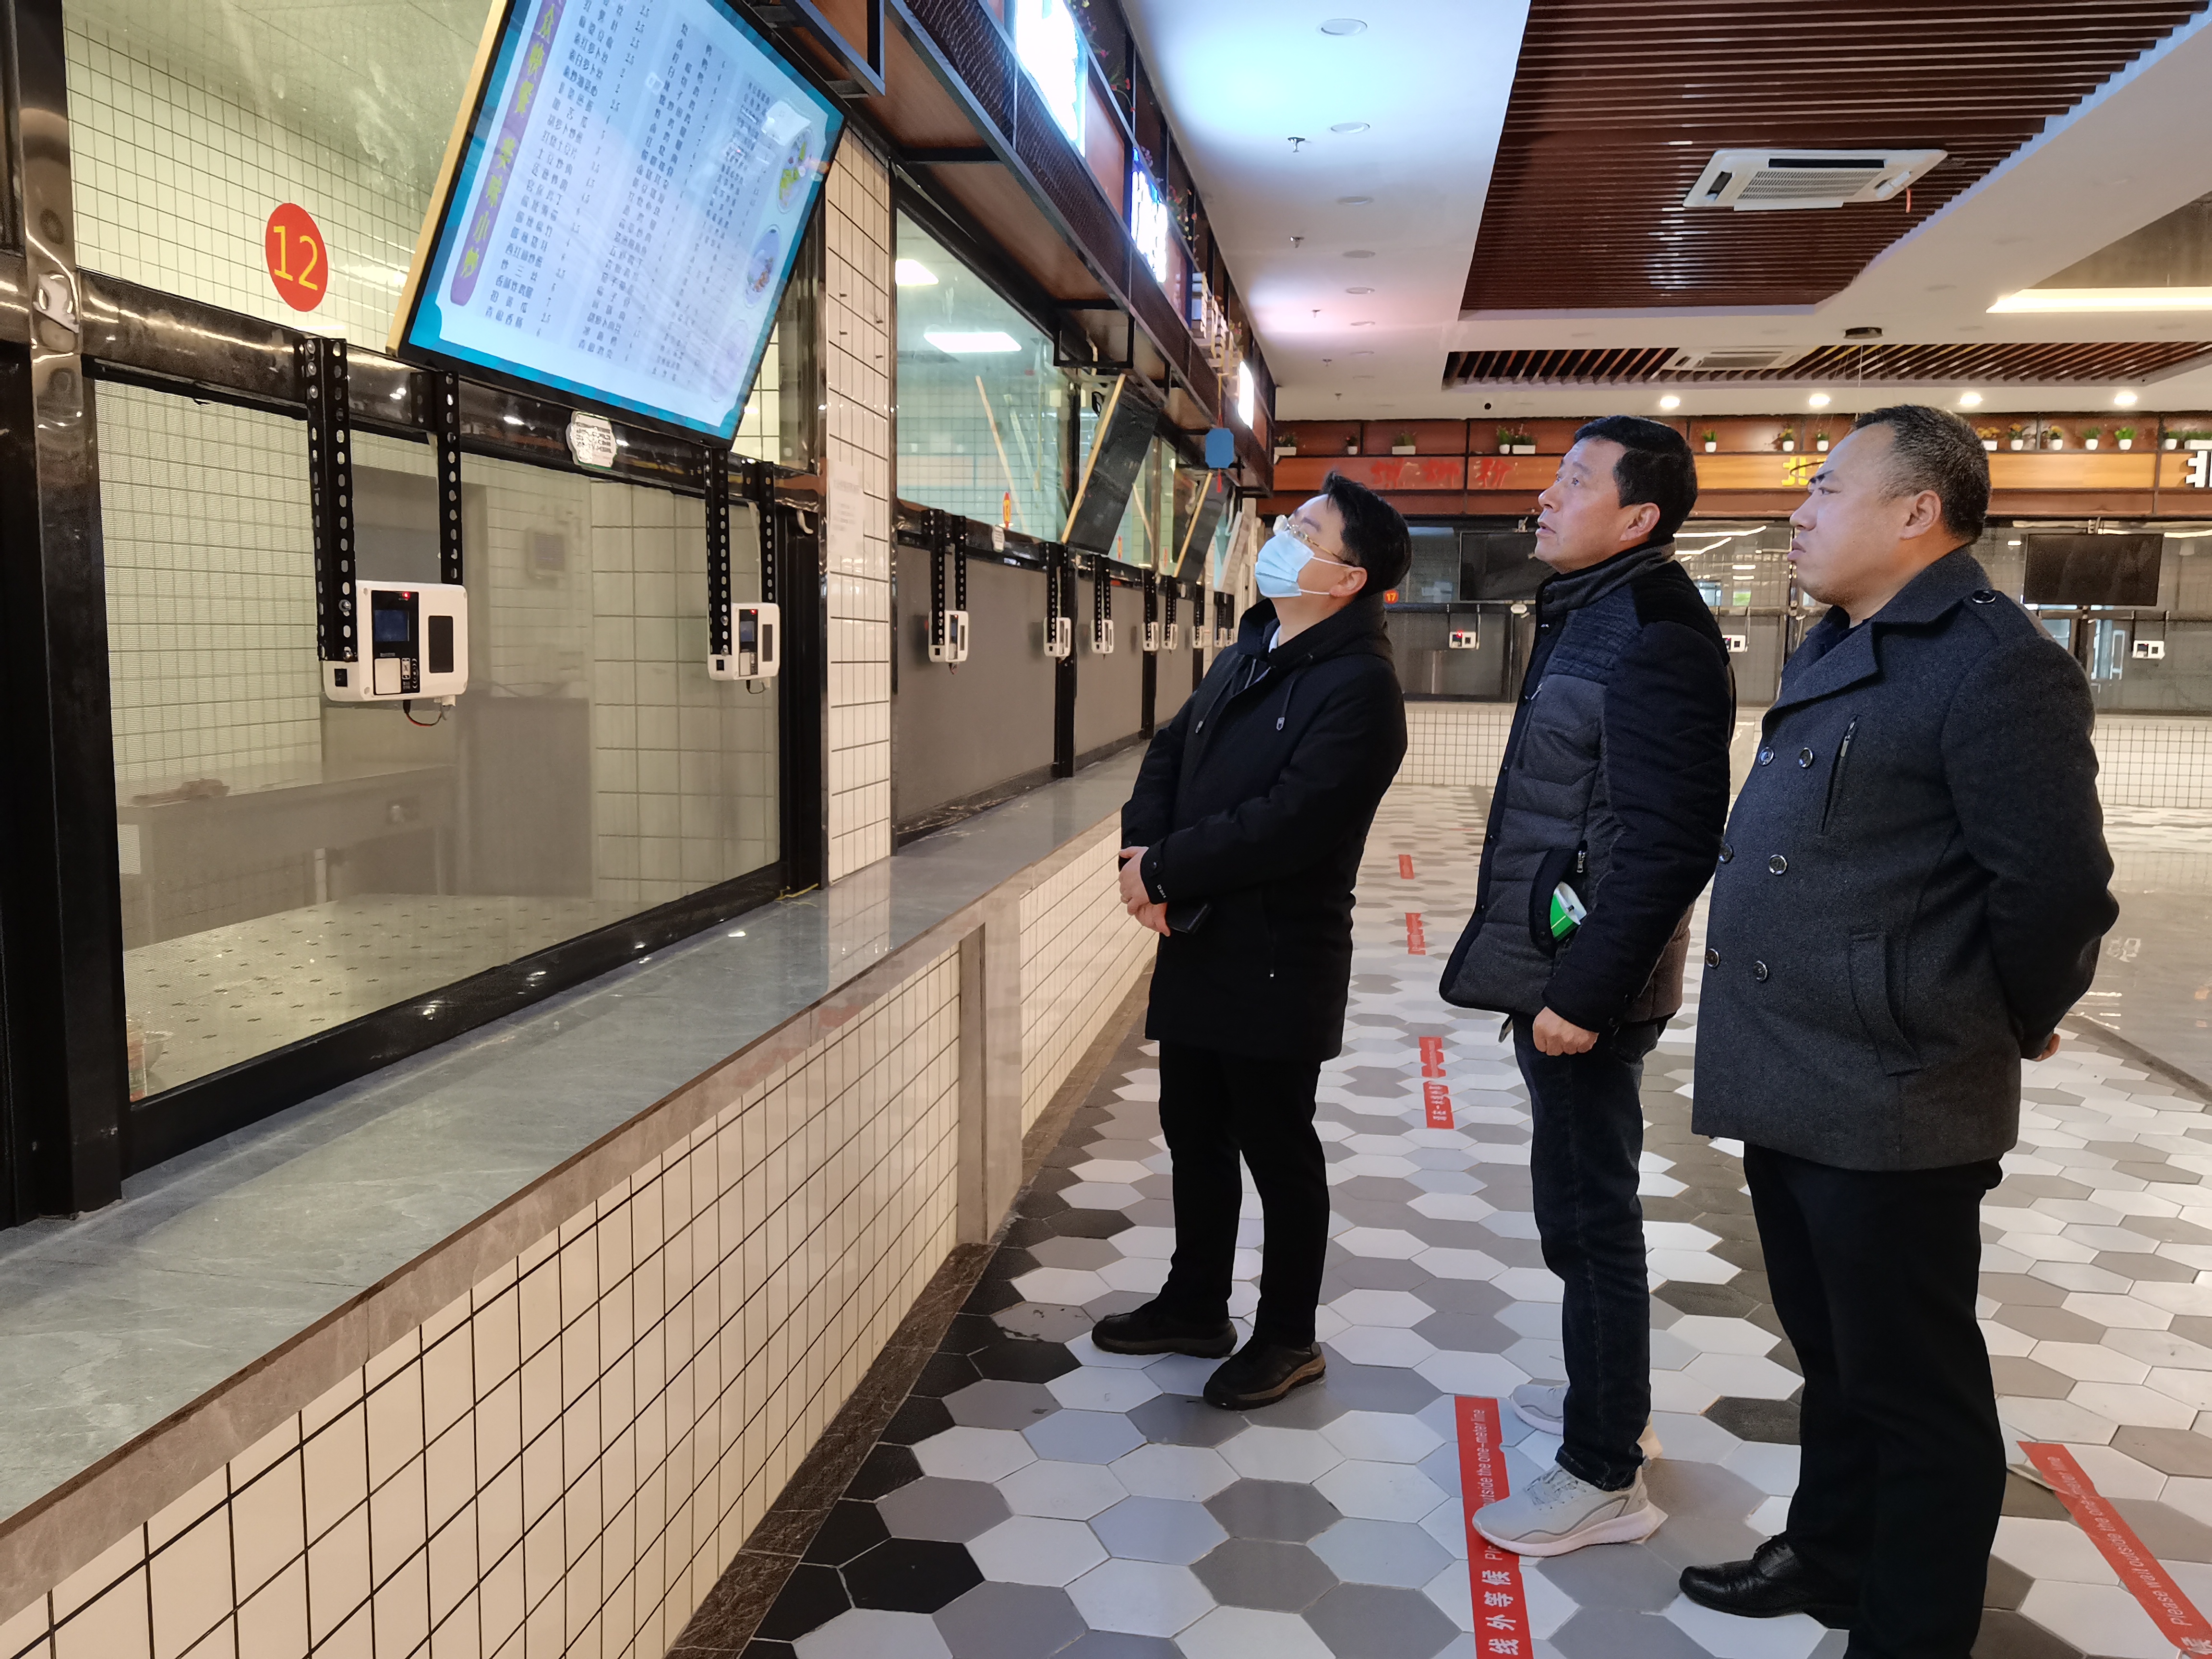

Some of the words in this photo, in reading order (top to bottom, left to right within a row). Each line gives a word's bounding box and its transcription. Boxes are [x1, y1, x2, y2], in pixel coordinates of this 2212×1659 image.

[515, 0, 563, 118] 众快餐
[460, 137, 516, 278] 美味小炒
[274, 226, 318, 290] 12
[1387, 592, 1396, 601] 17
[1476, 1463, 1492, 1477] the
[1477, 1477, 1496, 1507] utside
[2094, 1517, 2116, 1532] the
[2107, 1533, 2145, 1567] outside
[2131, 1567, 2162, 1588] wait
[1481, 1570, 1519, 1656] 线外等候
[2152, 1590, 2193, 1626] Please
